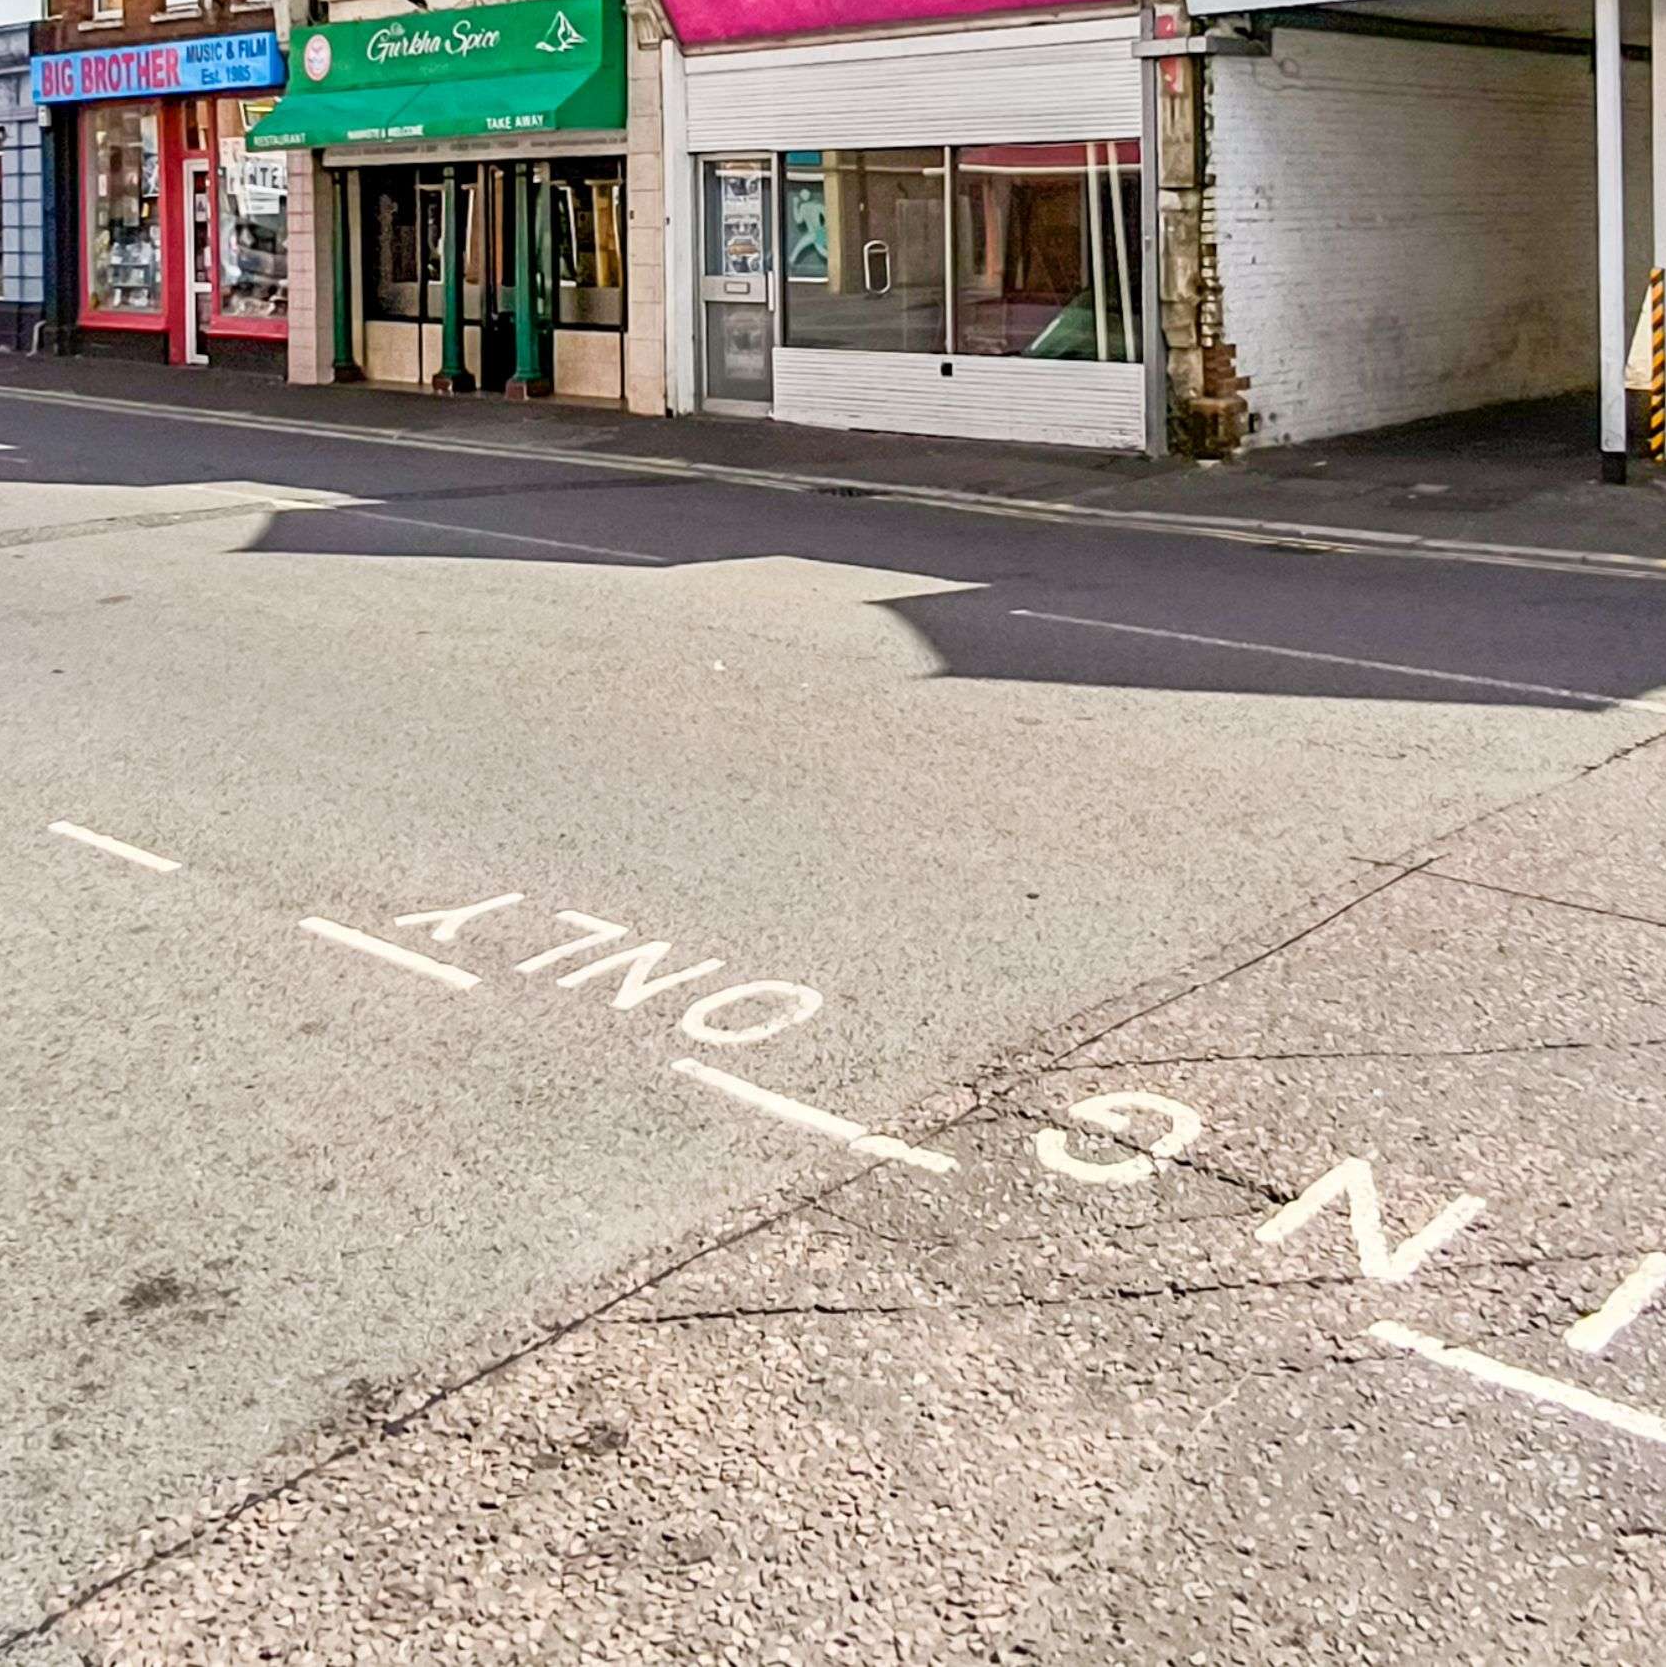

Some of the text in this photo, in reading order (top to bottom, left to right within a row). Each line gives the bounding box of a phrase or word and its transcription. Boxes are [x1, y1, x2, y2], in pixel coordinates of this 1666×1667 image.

[185, 37, 267, 63] MUSIC & FILM
[367, 27, 441, 64] Gurkha
[444, 20, 501, 57] Spice
[41, 48, 181, 97] BIG BROTHER
[486, 114, 544, 130] TAKE AWAY
[393, 890, 825, 1046] ONLY
